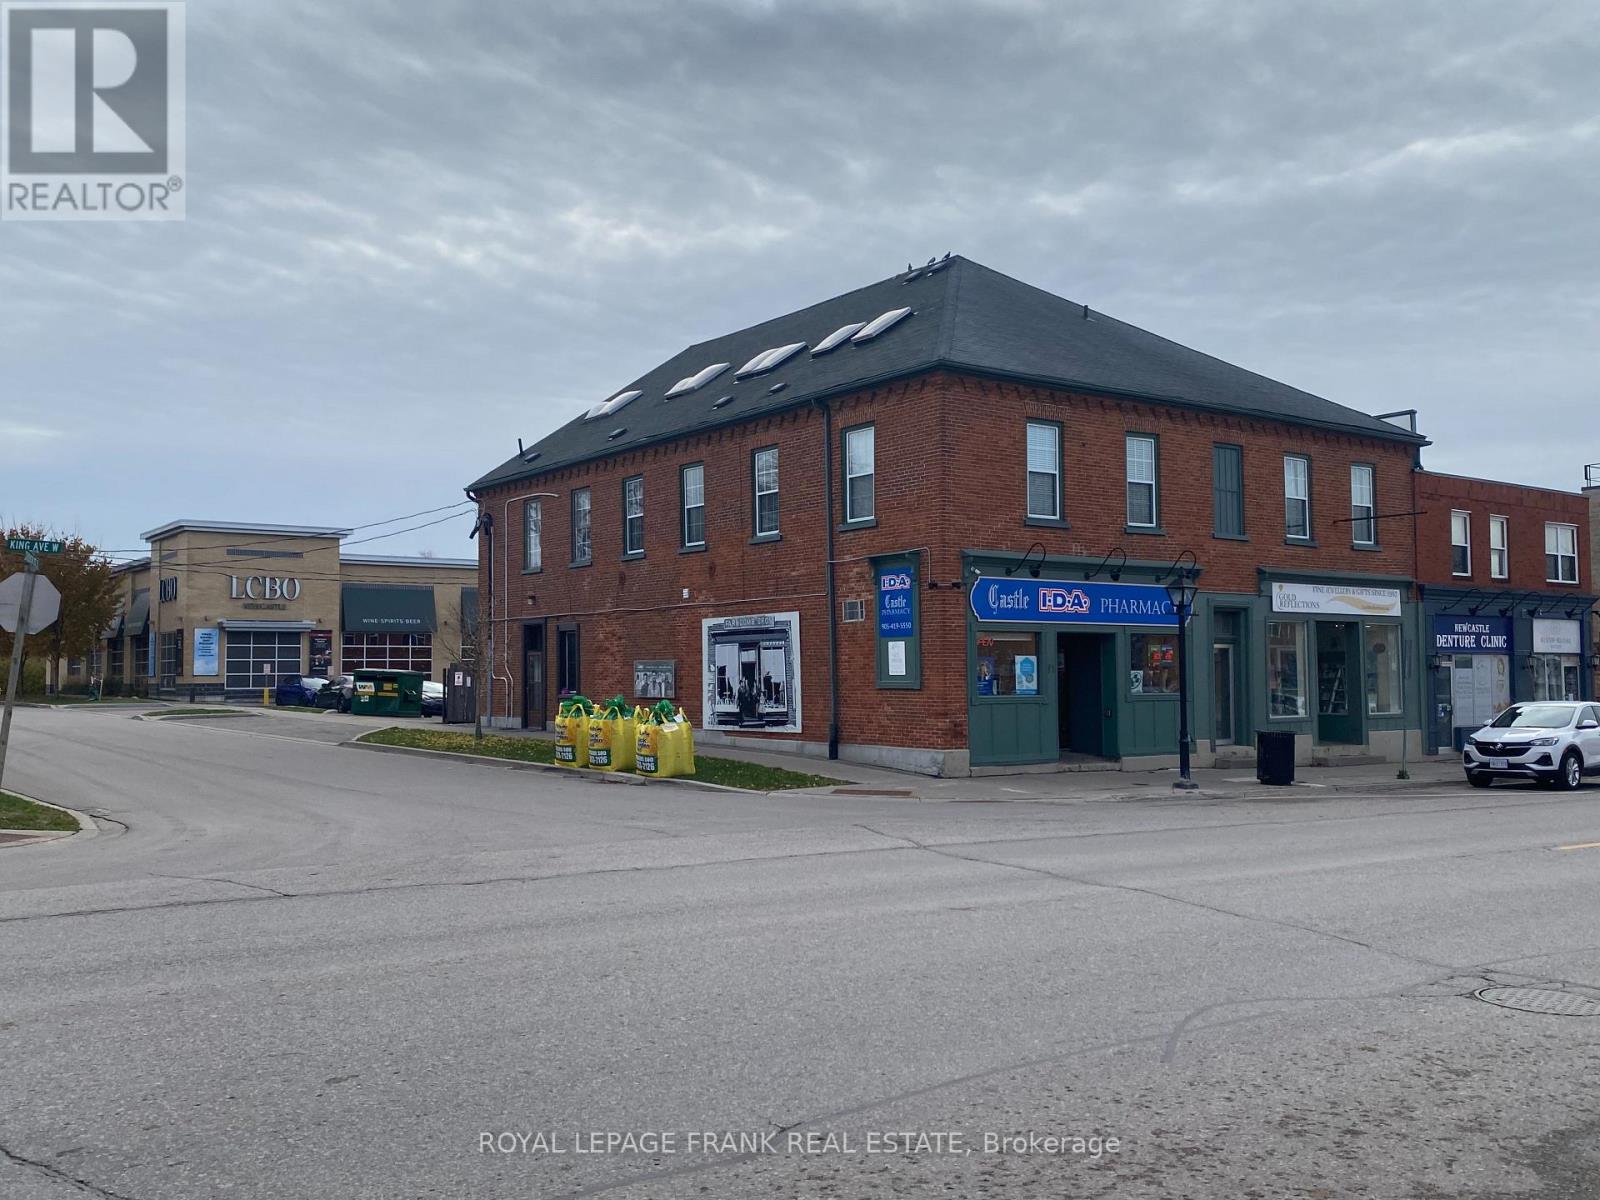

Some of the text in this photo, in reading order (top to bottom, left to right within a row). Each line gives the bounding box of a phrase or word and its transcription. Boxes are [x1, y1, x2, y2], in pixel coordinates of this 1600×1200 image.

[9, 539, 60, 553] KING AVE W
[230, 575, 301, 601] LCBO
[885, 594, 907, 609] Castle
[988, 583, 1030, 615] Castle
[1278, 593, 1297, 601] GOLD
[881, 607, 911, 617] PHARMACY
[1279, 601, 1320, 610] REFLECTIONS
[1454, 622, 1490, 633] NEWCASTLE
[1436, 634, 1507, 648] DENTURE CLINIC
